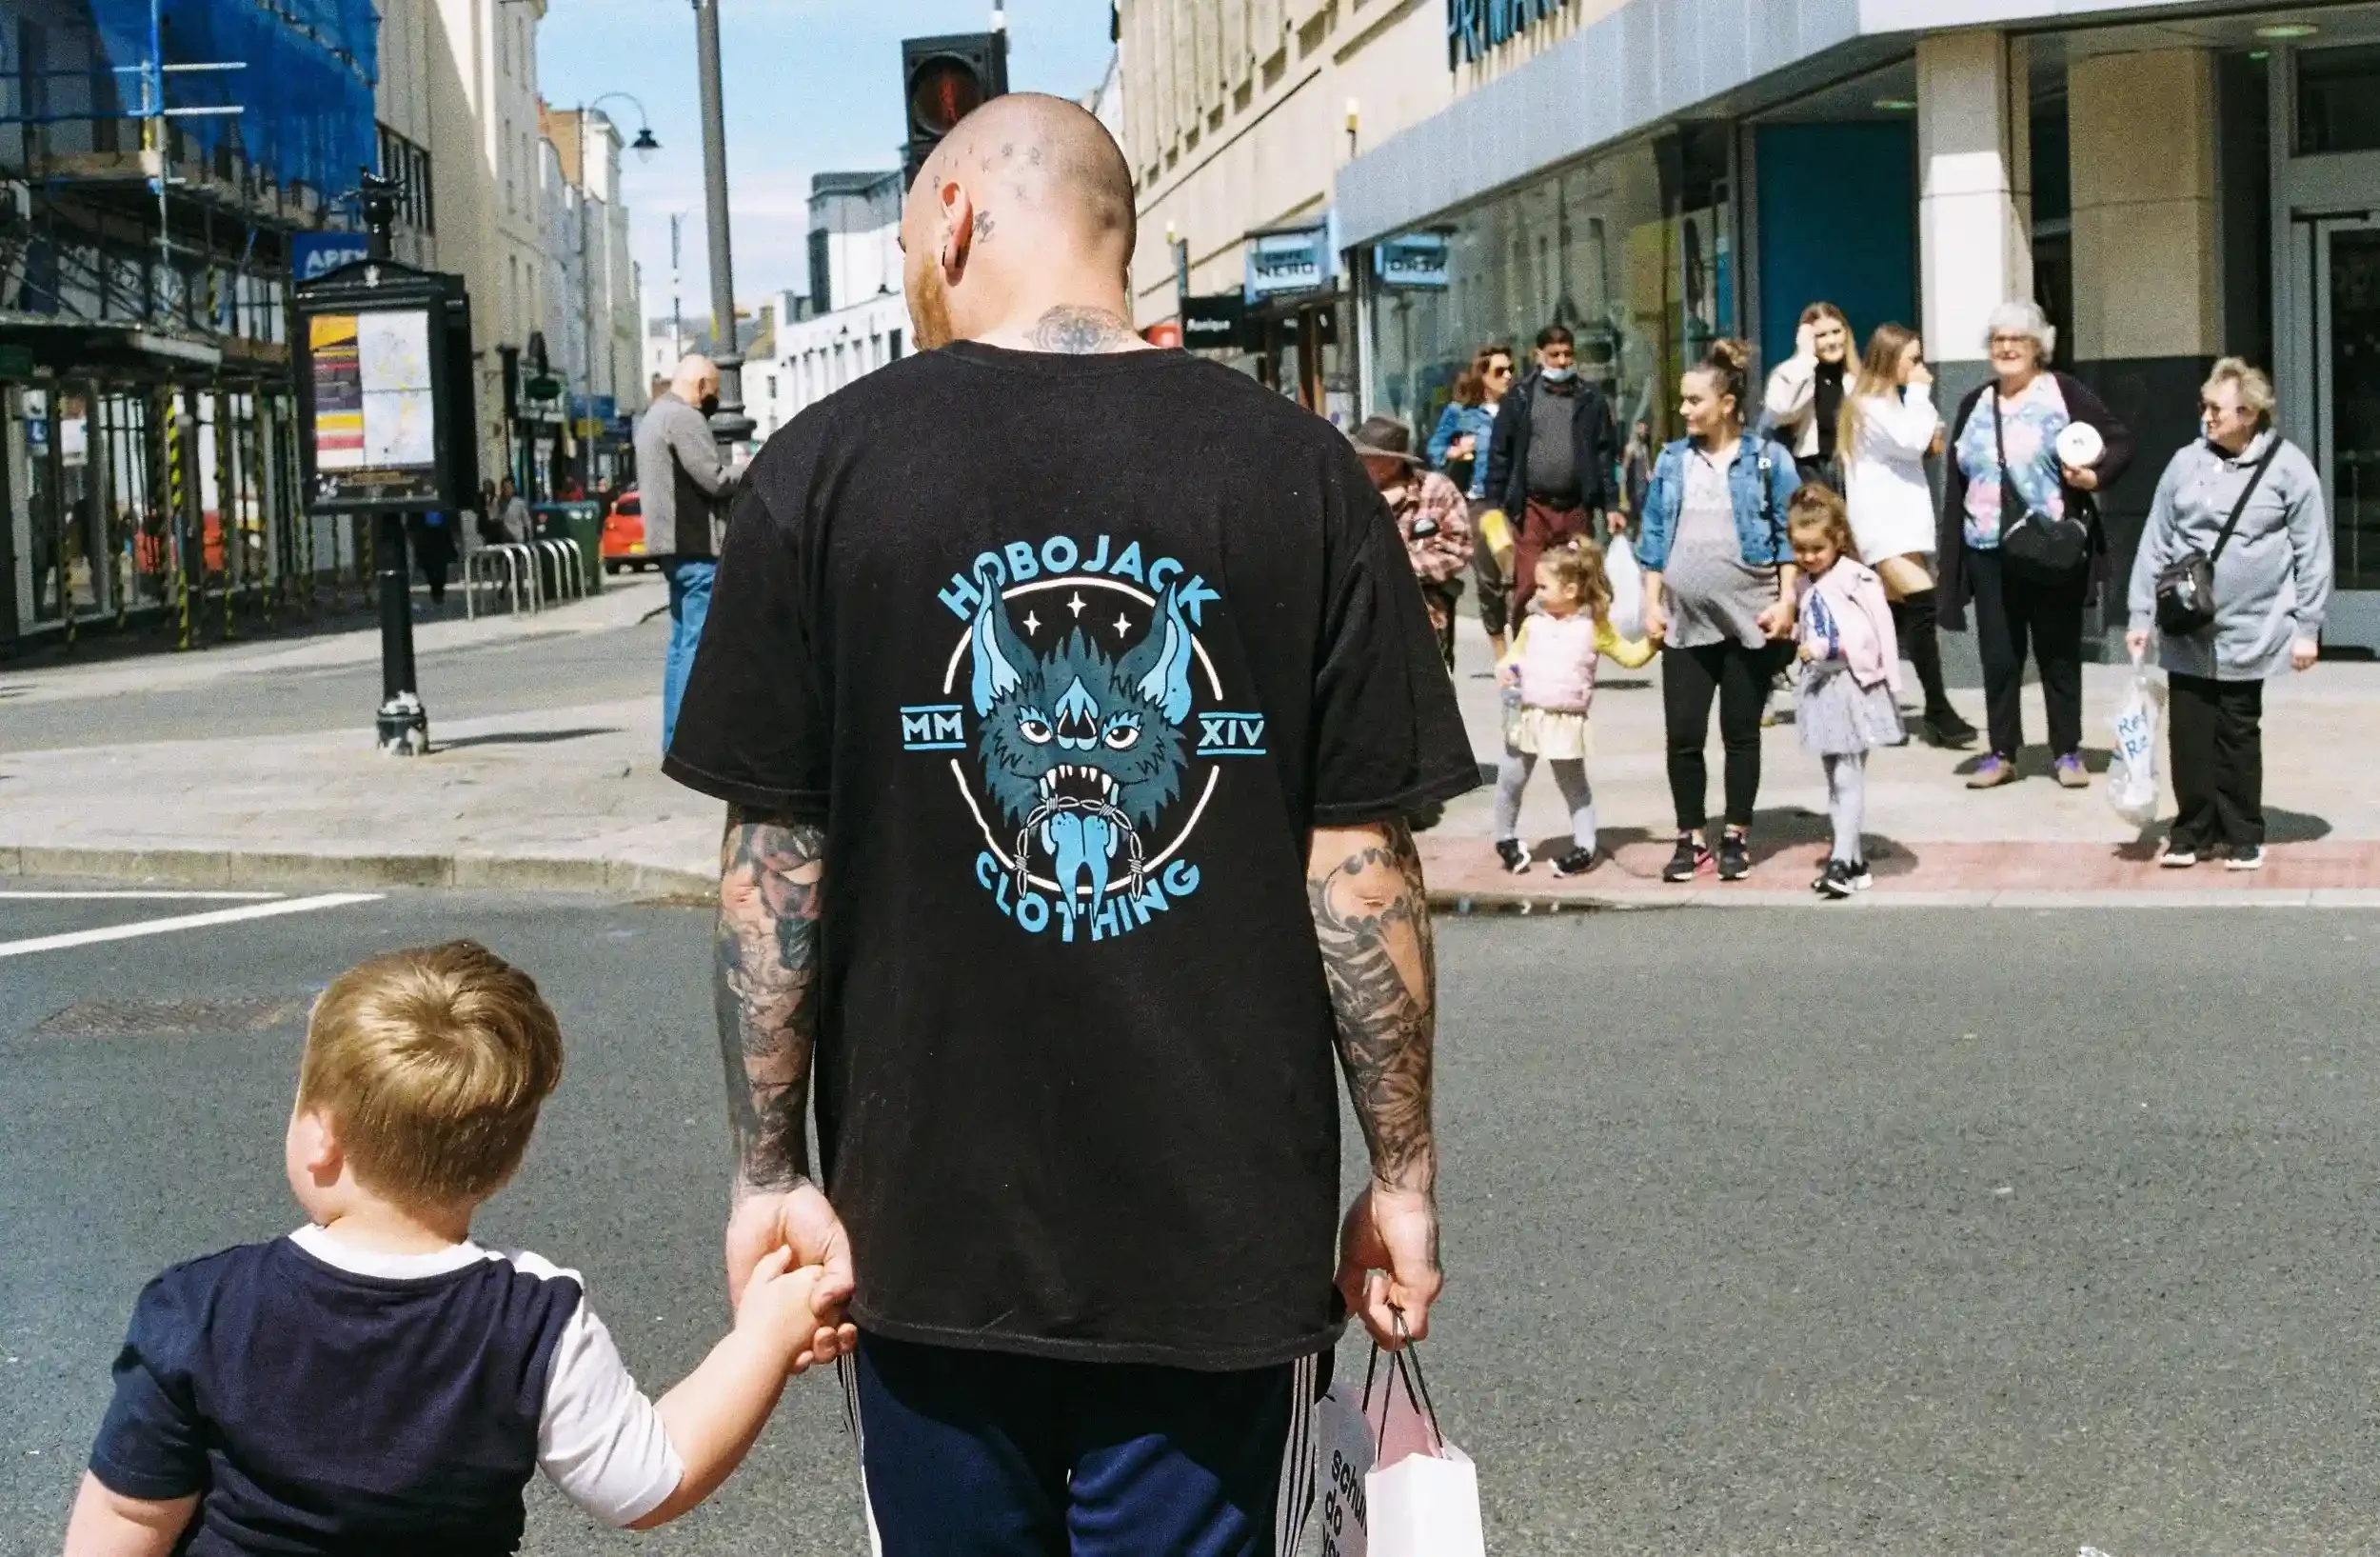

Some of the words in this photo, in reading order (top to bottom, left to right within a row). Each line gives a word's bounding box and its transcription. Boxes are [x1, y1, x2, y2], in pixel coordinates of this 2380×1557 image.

[937, 535, 1221, 628] HOBOJACK
[901, 712, 964, 743] MM
[1198, 717, 1266, 748] XIV
[976, 851, 1200, 943] CLOTHING
[1324, 1487, 1342, 1537] do
[1321, 1524, 1339, 1557] yo
